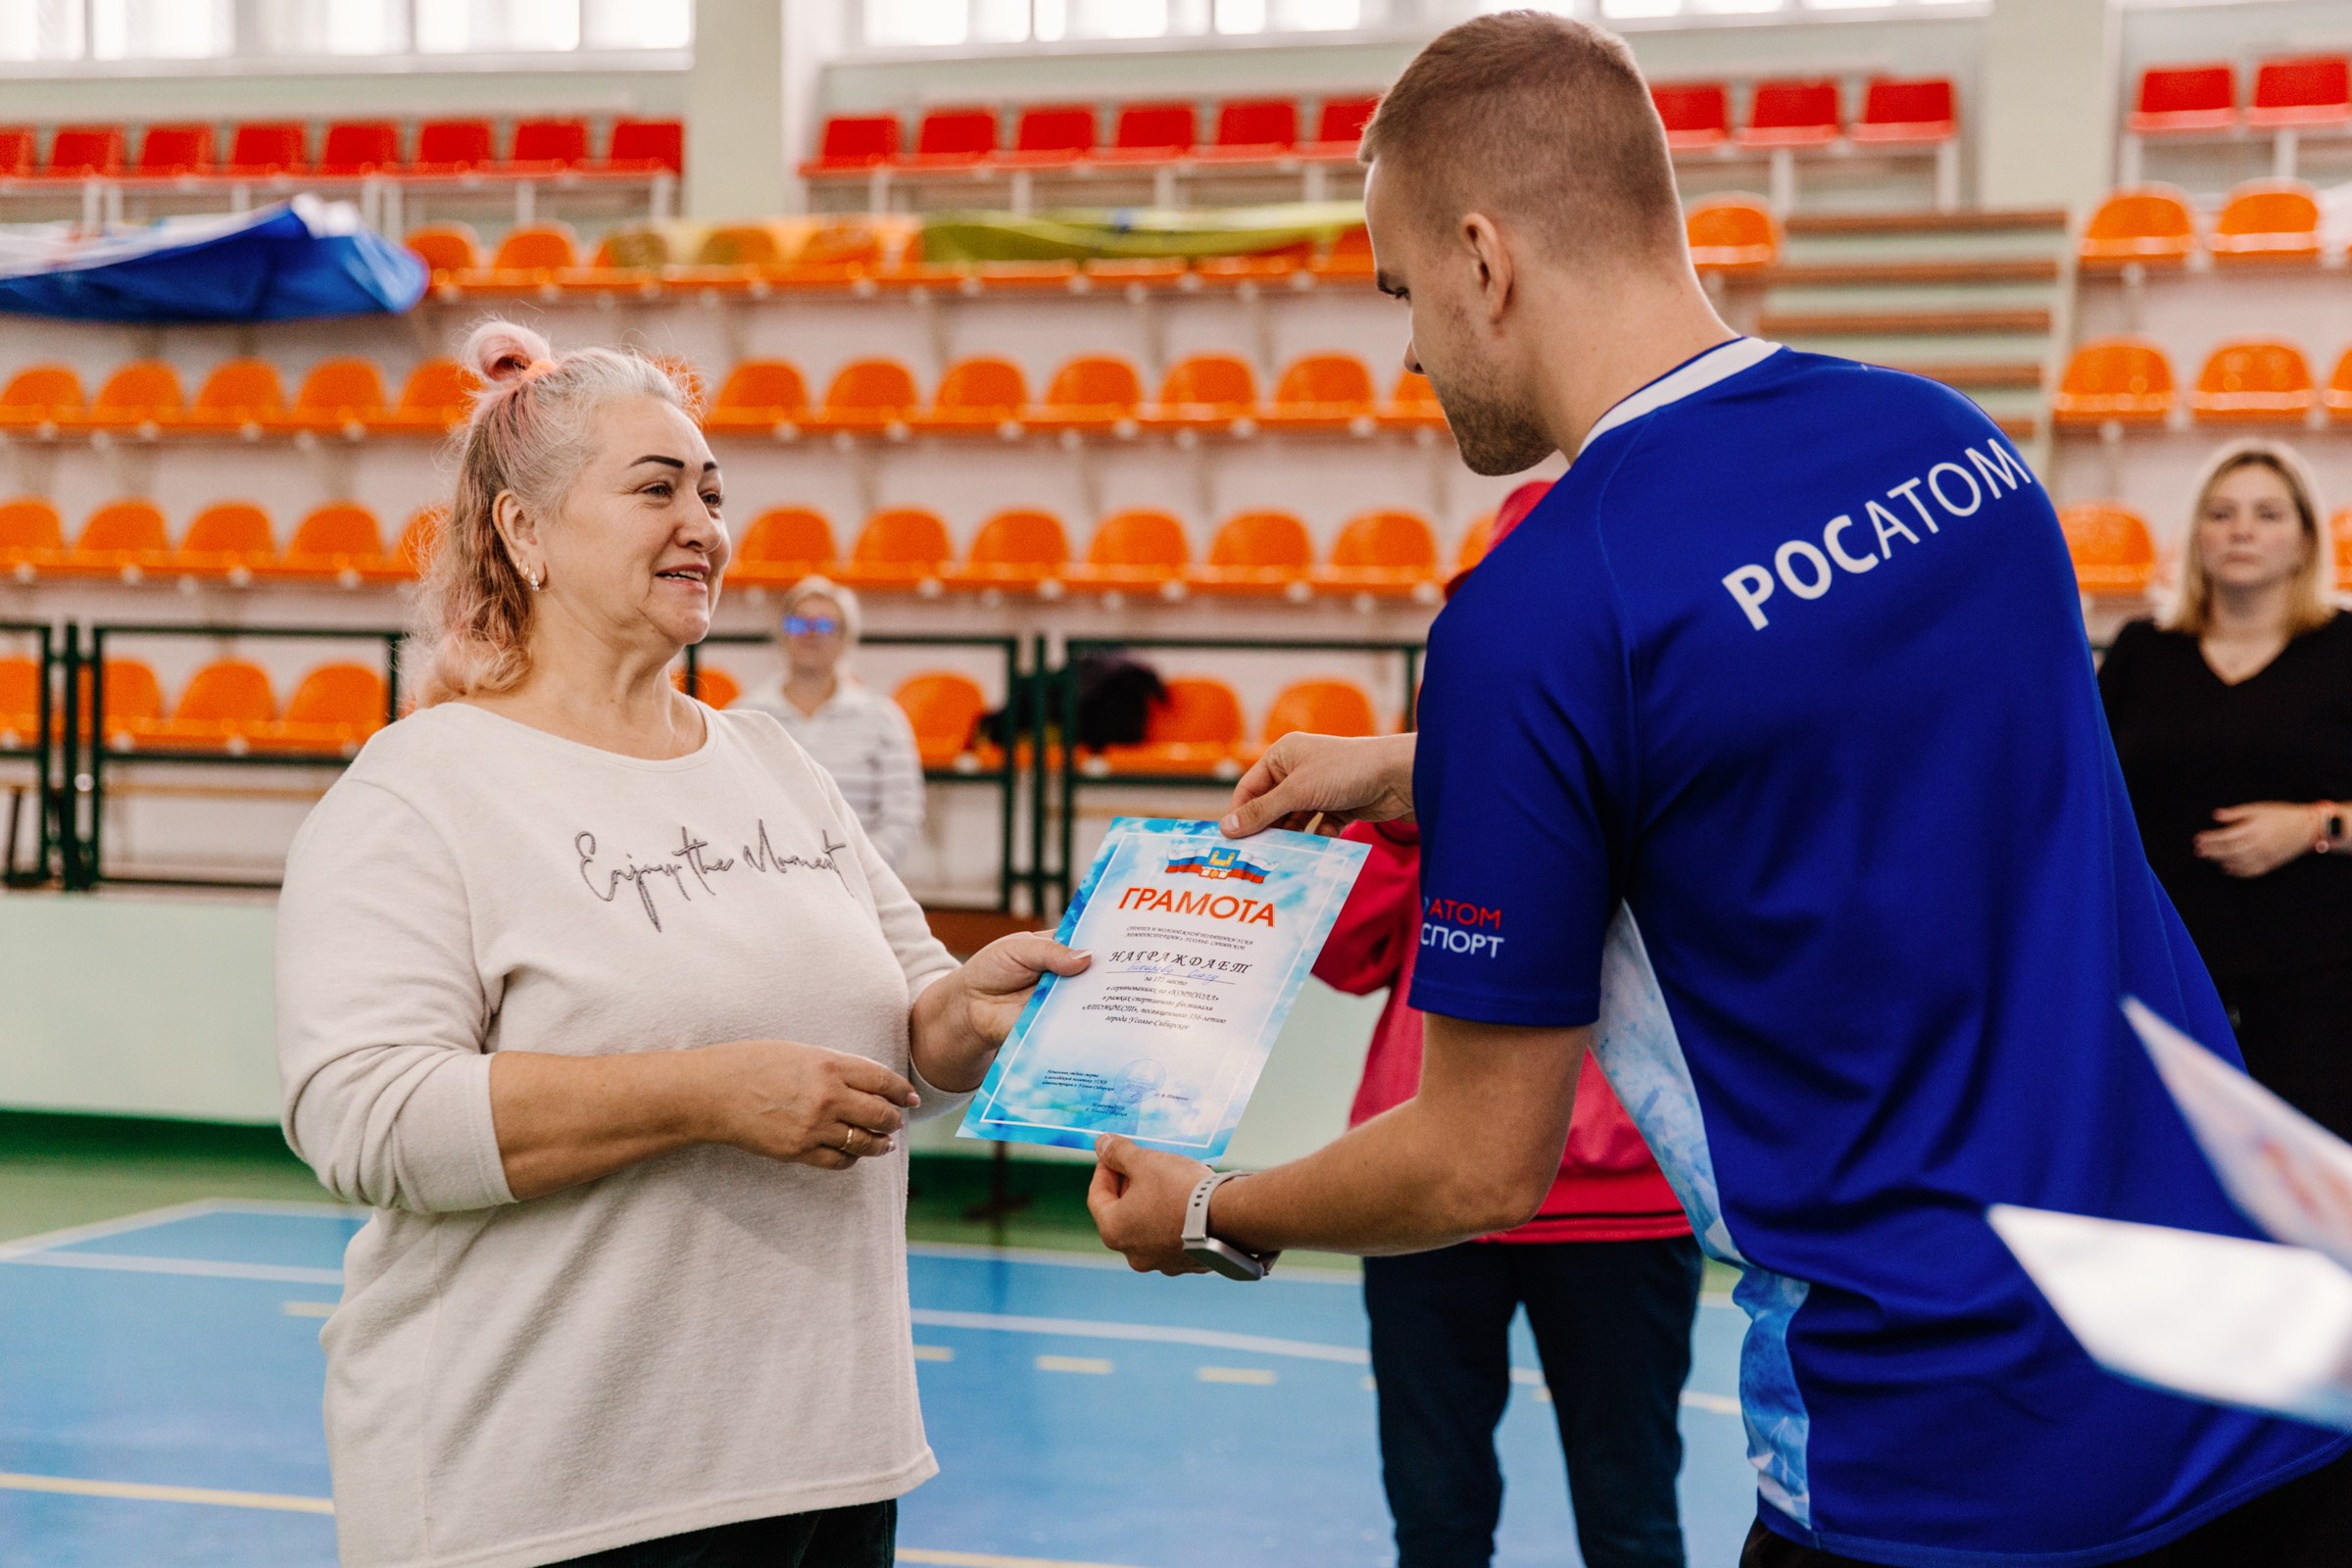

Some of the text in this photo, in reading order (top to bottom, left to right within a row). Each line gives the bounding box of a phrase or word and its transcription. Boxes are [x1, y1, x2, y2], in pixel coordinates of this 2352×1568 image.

[1722, 438, 2032, 630] РОСАТОМ
[575, 819, 855, 933] Enjoy the Moment
[1117, 887, 1275, 928] ГРАМОТА
[1429, 898, 1502, 930] АТОМ
[1420, 923, 1505, 958] СПОРТ
[1109, 951, 1252, 974] НАГРАЖДАЕТ
